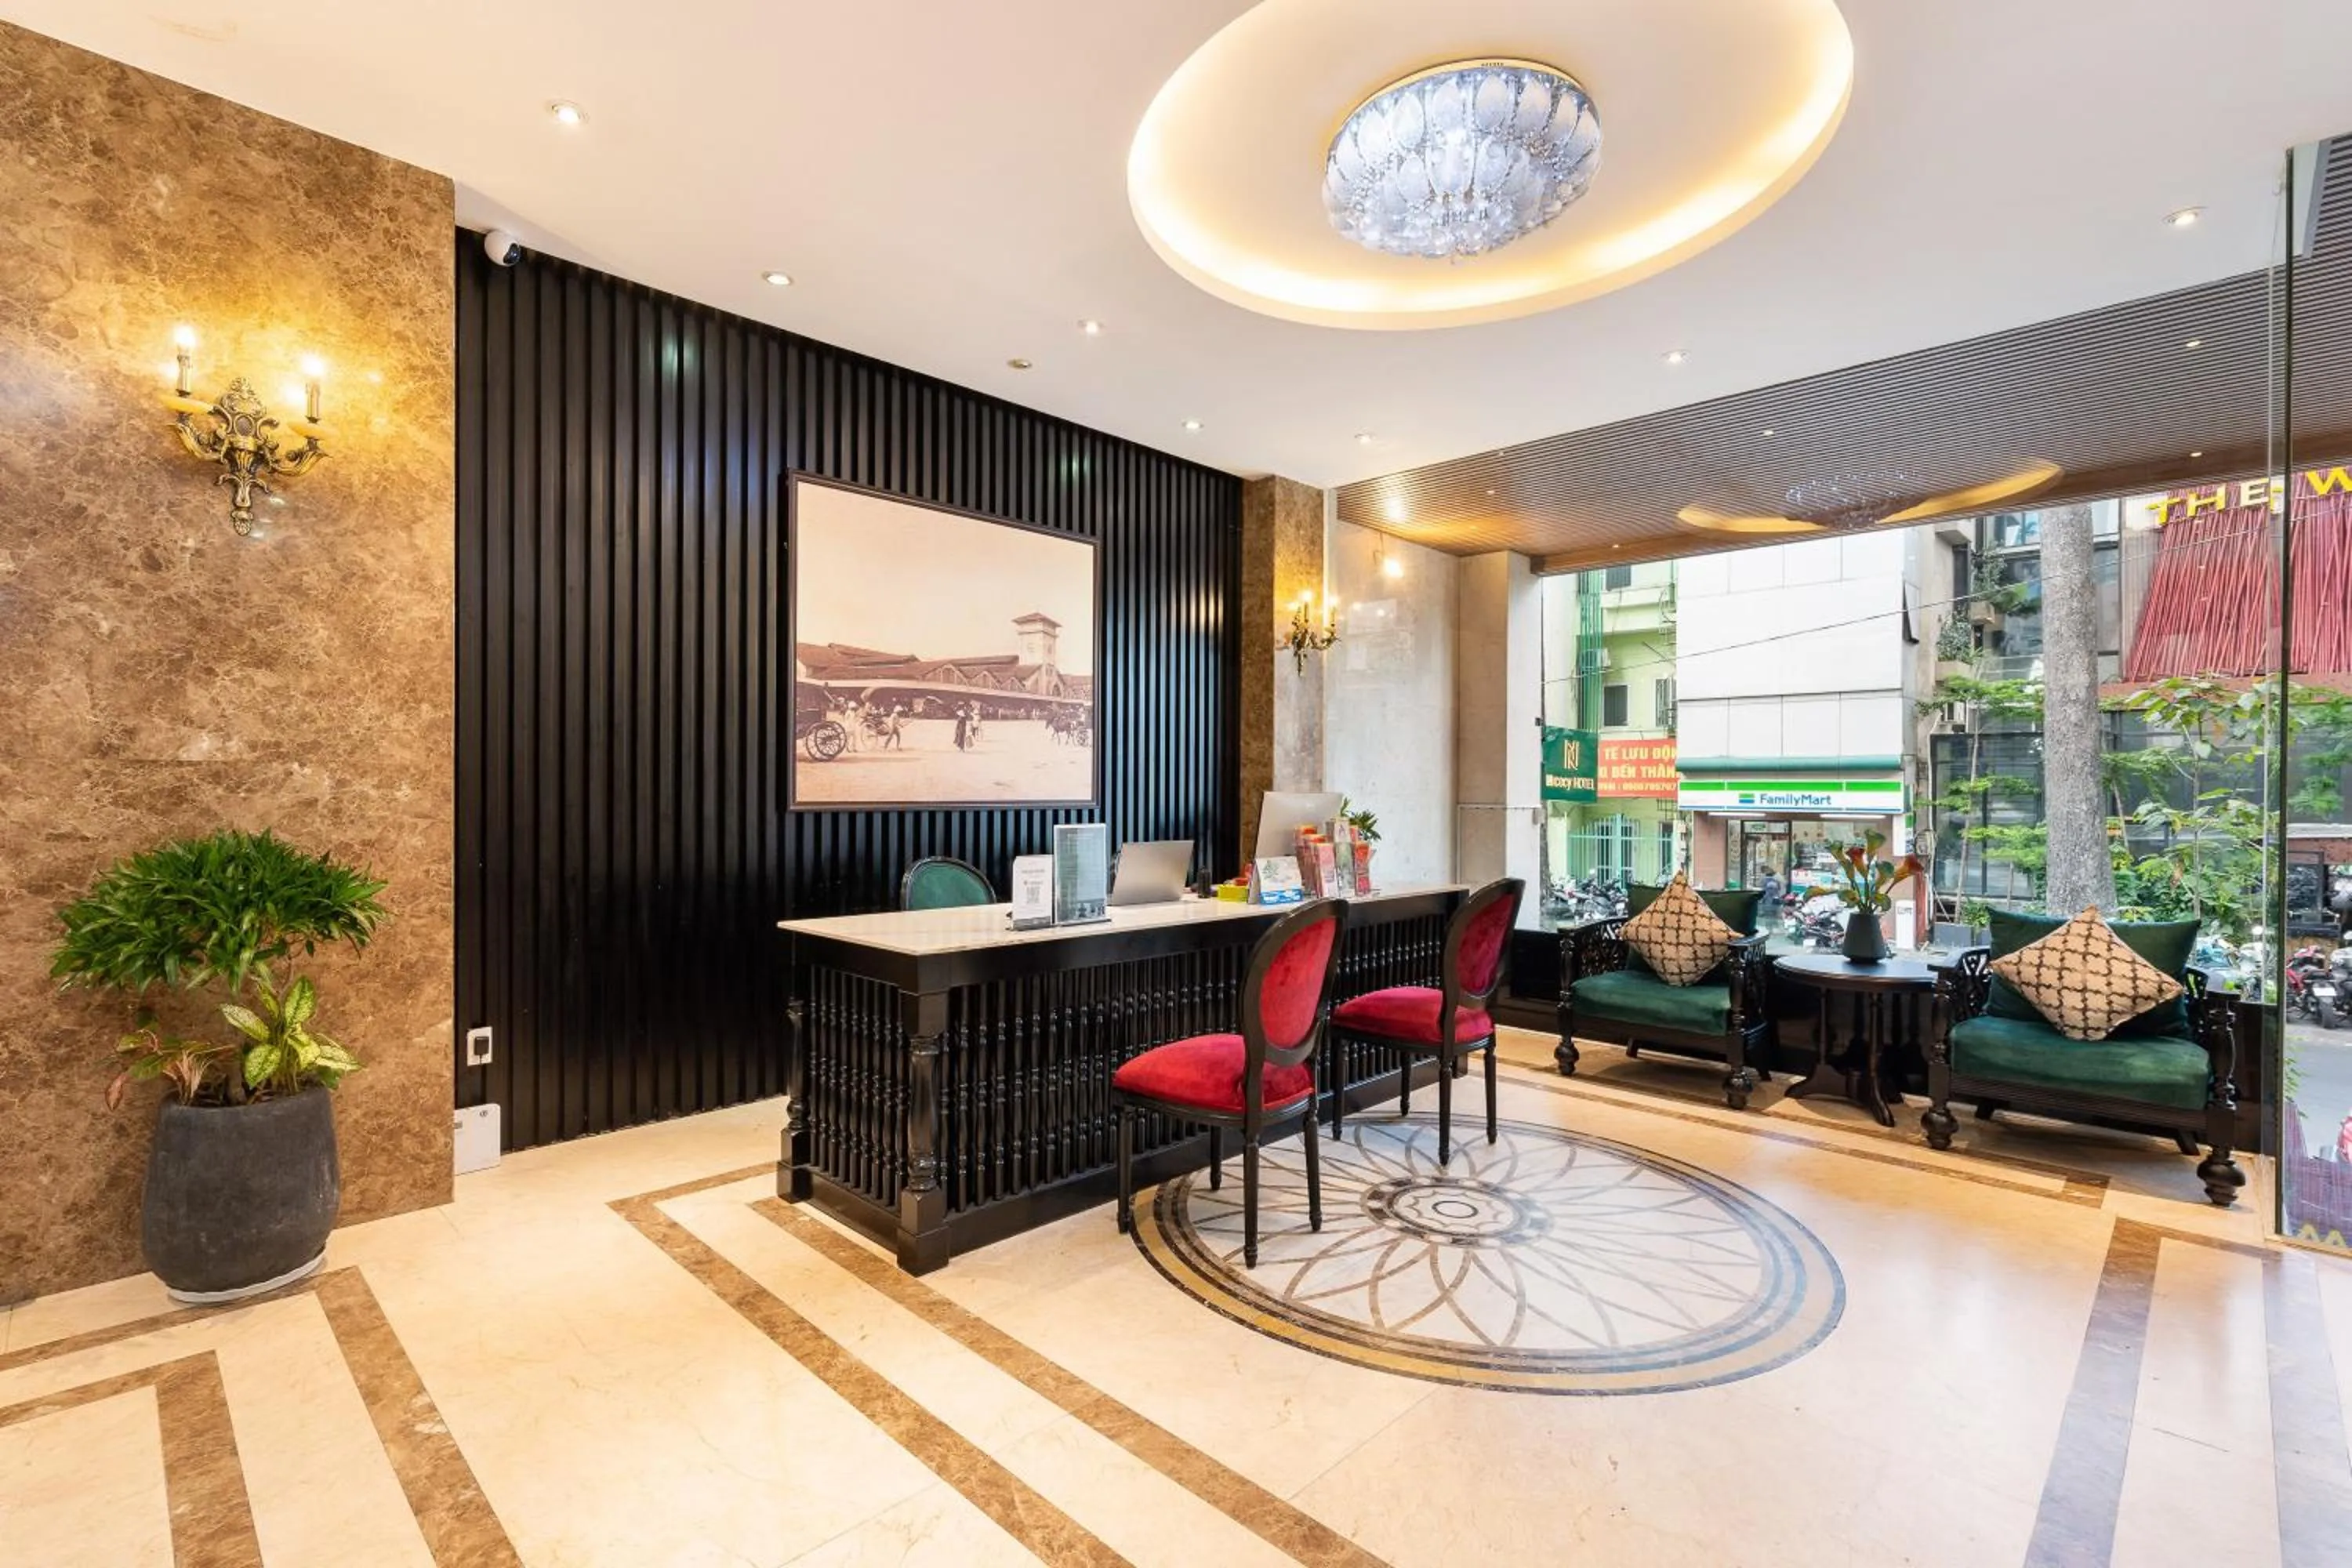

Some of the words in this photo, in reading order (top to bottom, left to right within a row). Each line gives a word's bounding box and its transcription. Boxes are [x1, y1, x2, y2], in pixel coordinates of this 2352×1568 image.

[2145, 478, 2269, 525] THE
[1640, 763, 1676, 778] THÀN
[1760, 793, 1831, 806] FamilyMart
